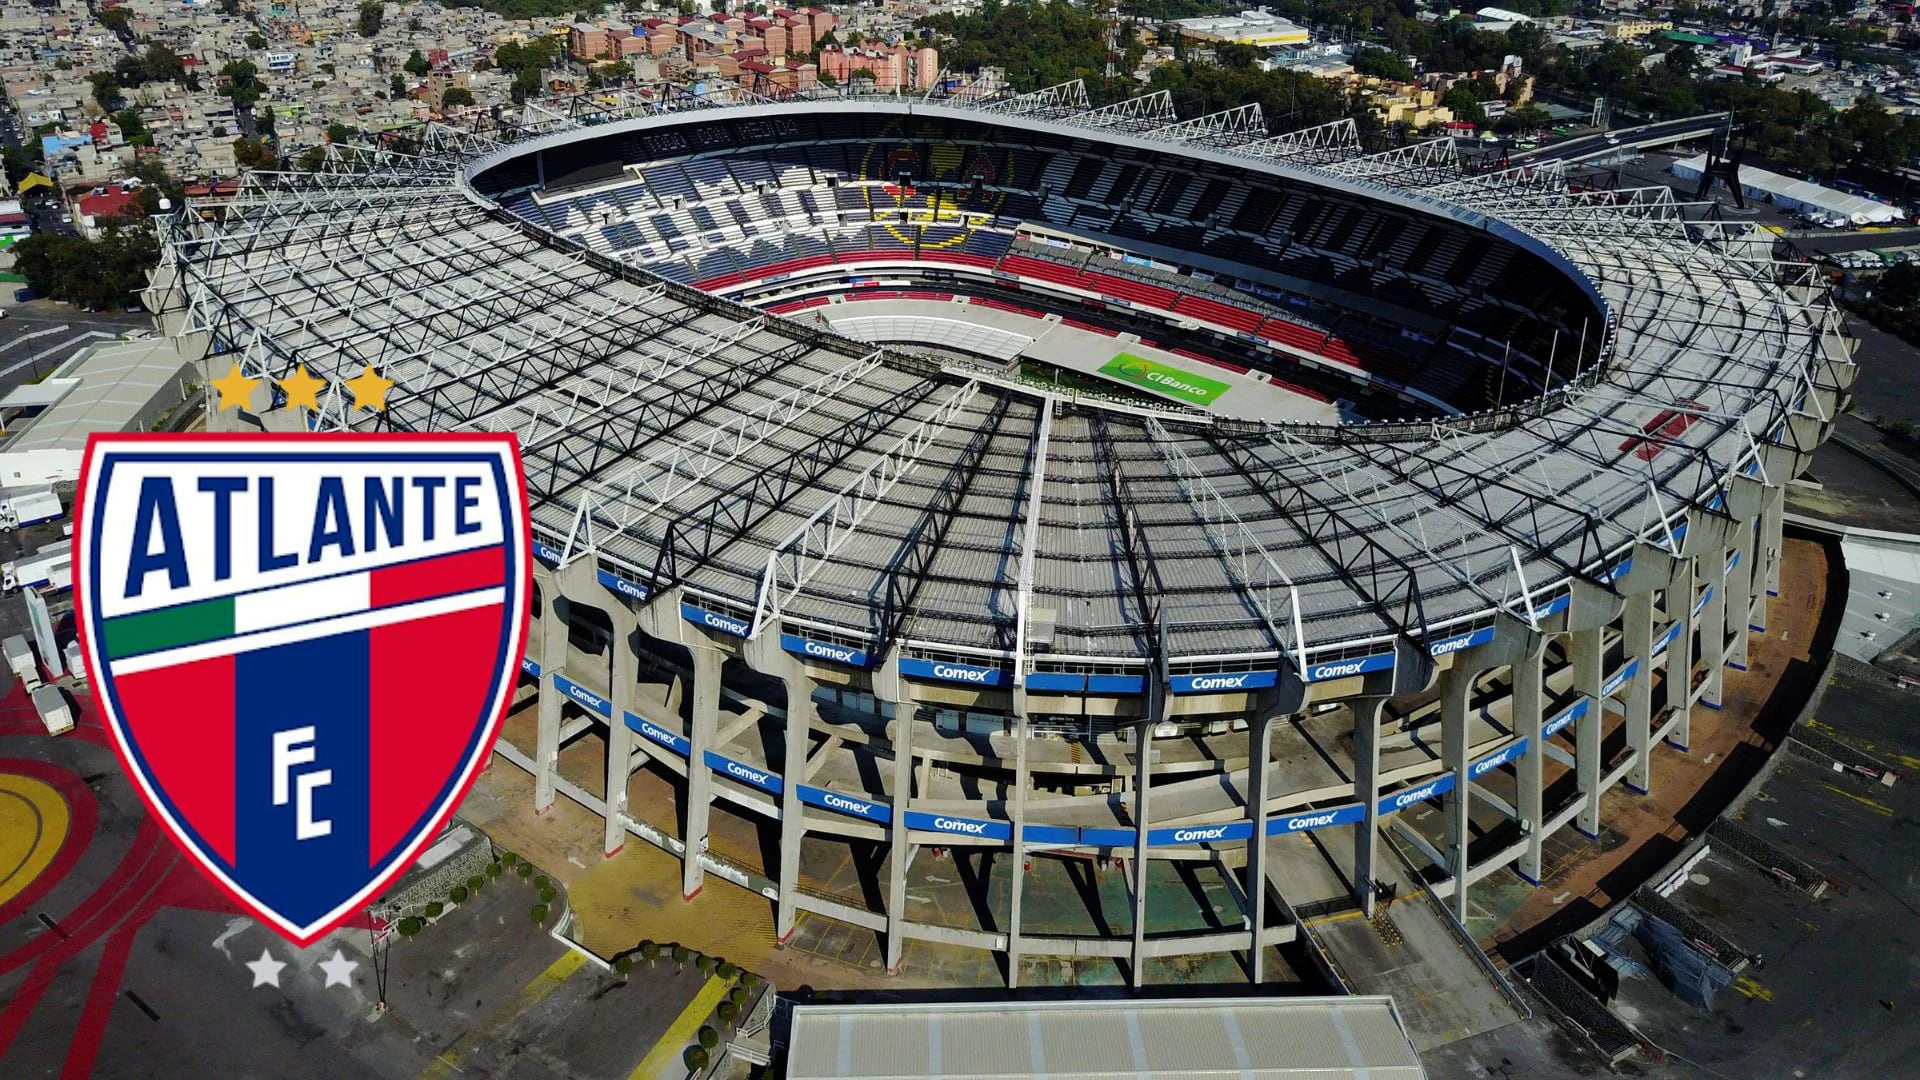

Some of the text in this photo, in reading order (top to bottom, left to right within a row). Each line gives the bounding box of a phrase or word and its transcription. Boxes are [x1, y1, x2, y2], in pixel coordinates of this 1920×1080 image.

[540, 546, 561, 564] Com
[617, 581, 647, 600] Come
[704, 614, 749, 636] Comex
[805, 642, 857, 662] Comex
[1431, 634, 1474, 656] Comex
[934, 665, 991, 682] Comex
[1314, 659, 1366, 679] Comex
[1191, 674, 1248, 690] Comex
[569, 686, 602, 708] Comex
[1546, 709, 1574, 735] Comex
[641, 723, 677, 746] Comex
[1475, 749, 1509, 774] Comex
[727, 762, 769, 784] Comex
[1396, 782, 1436, 806] Comex
[824, 794, 872, 815] Comex
[934, 818, 988, 834] Comex
[1288, 811, 1338, 831] Comex
[1174, 826, 1227, 842] Comex
